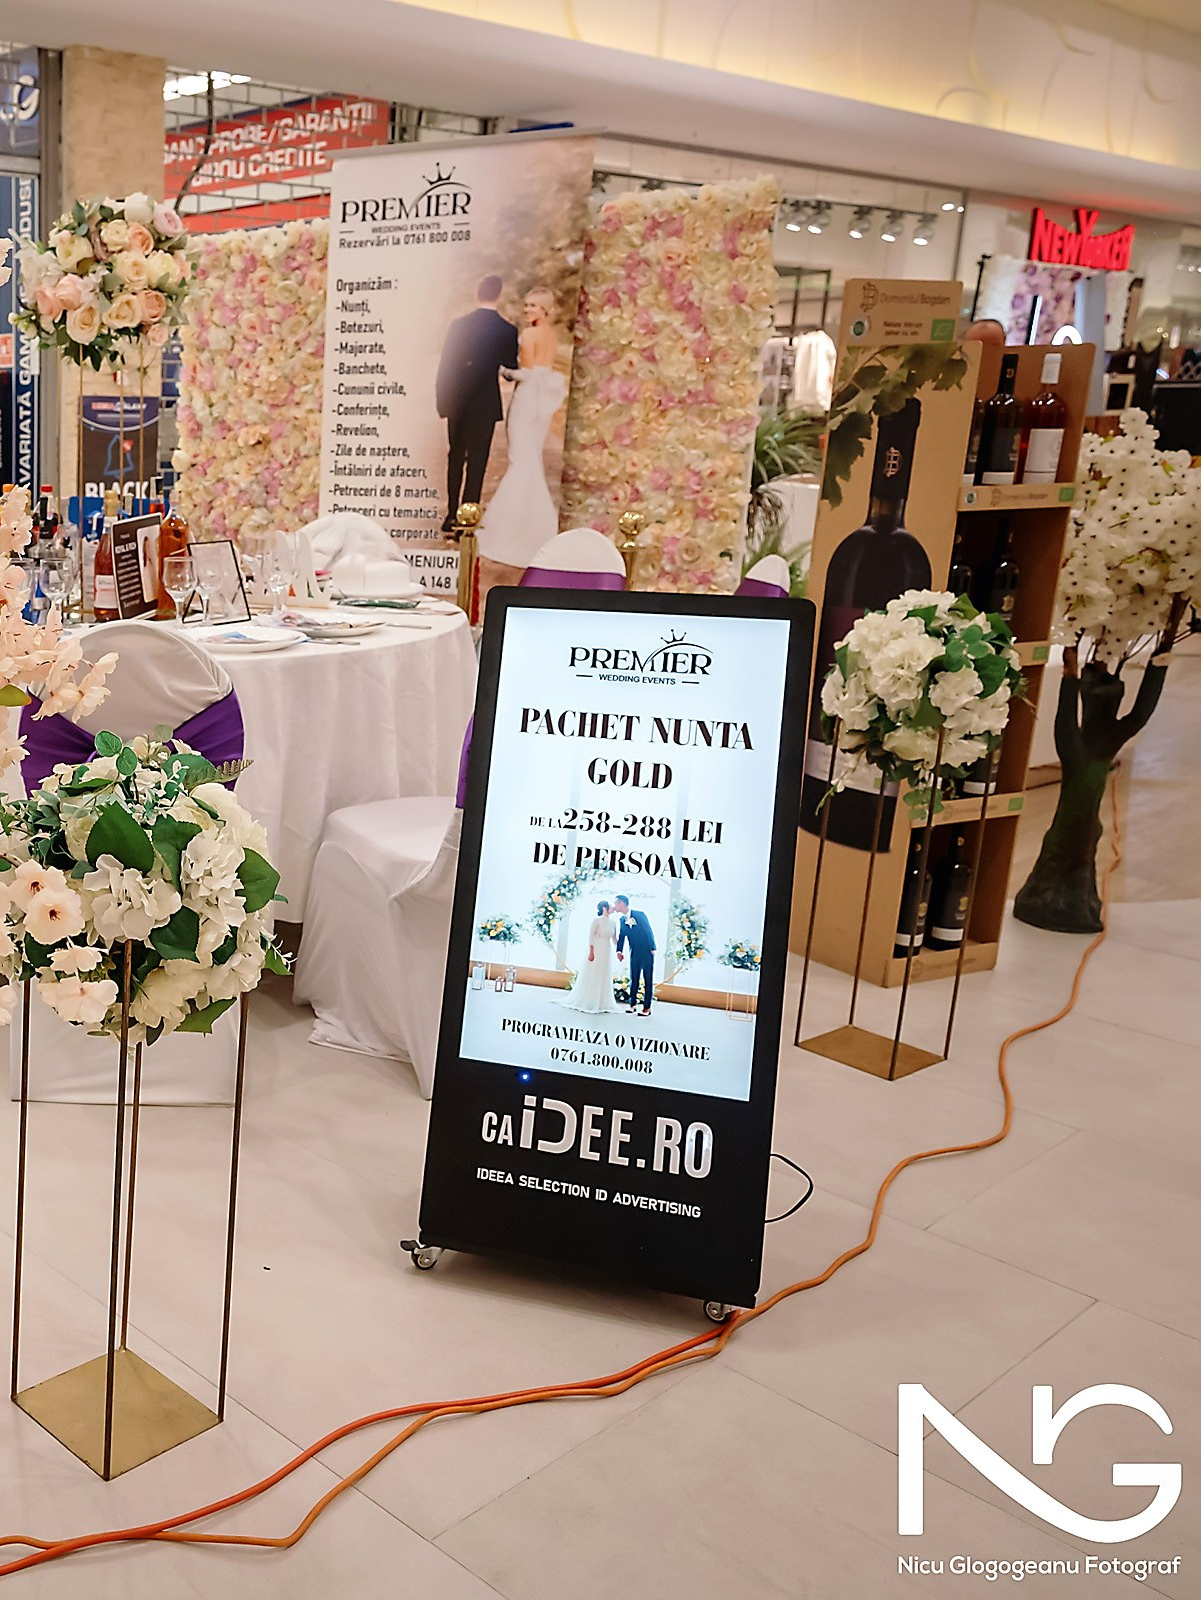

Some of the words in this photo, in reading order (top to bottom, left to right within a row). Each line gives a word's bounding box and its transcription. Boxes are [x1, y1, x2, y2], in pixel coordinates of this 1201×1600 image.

[340, 191, 472, 224] PREMIER
[339, 236, 389, 250] Rezervări
[392, 235, 401, 246] la
[404, 233, 426, 246] 0761
[429, 232, 448, 243] 800
[451, 230, 471, 242] 008
[371, 225, 407, 234] WEDDING
[410, 222, 441, 232] EVENTS
[336, 276, 392, 295] Organizăm
[19, 335, 32, 386] GAM
[17, 391, 32, 483] VARIATĂ
[330, 444, 352, 457] -Zile
[355, 444, 367, 457] de
[375, 465, 387, 477] de
[329, 483, 377, 498] -Petreceri
[380, 485, 391, 498] de
[394, 485, 401, 498] 8
[379, 507, 390, 518] cu
[432, 576, 451, 589] 148
[568, 646, 713, 676] PREMIER
[599, 673, 640, 684] WEDDING
[642, 676, 676, 687] EVENTS
[519, 707, 640, 742] PACHET
[648, 716, 754, 751] NUNTA
[587, 757, 673, 790] GOLD
[562, 807, 672, 840] 258-288
[681, 819, 724, 845] LEI
[532, 841, 567, 867] DE
[575, 845, 713, 882] PERSOANA
[501, 1018, 610, 1047] PROGRAMEAZA
[615, 1034, 626, 1049] O
[630, 1036, 711, 1061] VIZIONARE
[550, 1046, 654, 1075] 0761.800.008
[476, 1167, 514, 1185] IDEEA
[518, 1175, 590, 1200] SELECTION
[595, 1188, 608, 1201] ID
[612, 1193, 702, 1219] ADVERTISING
